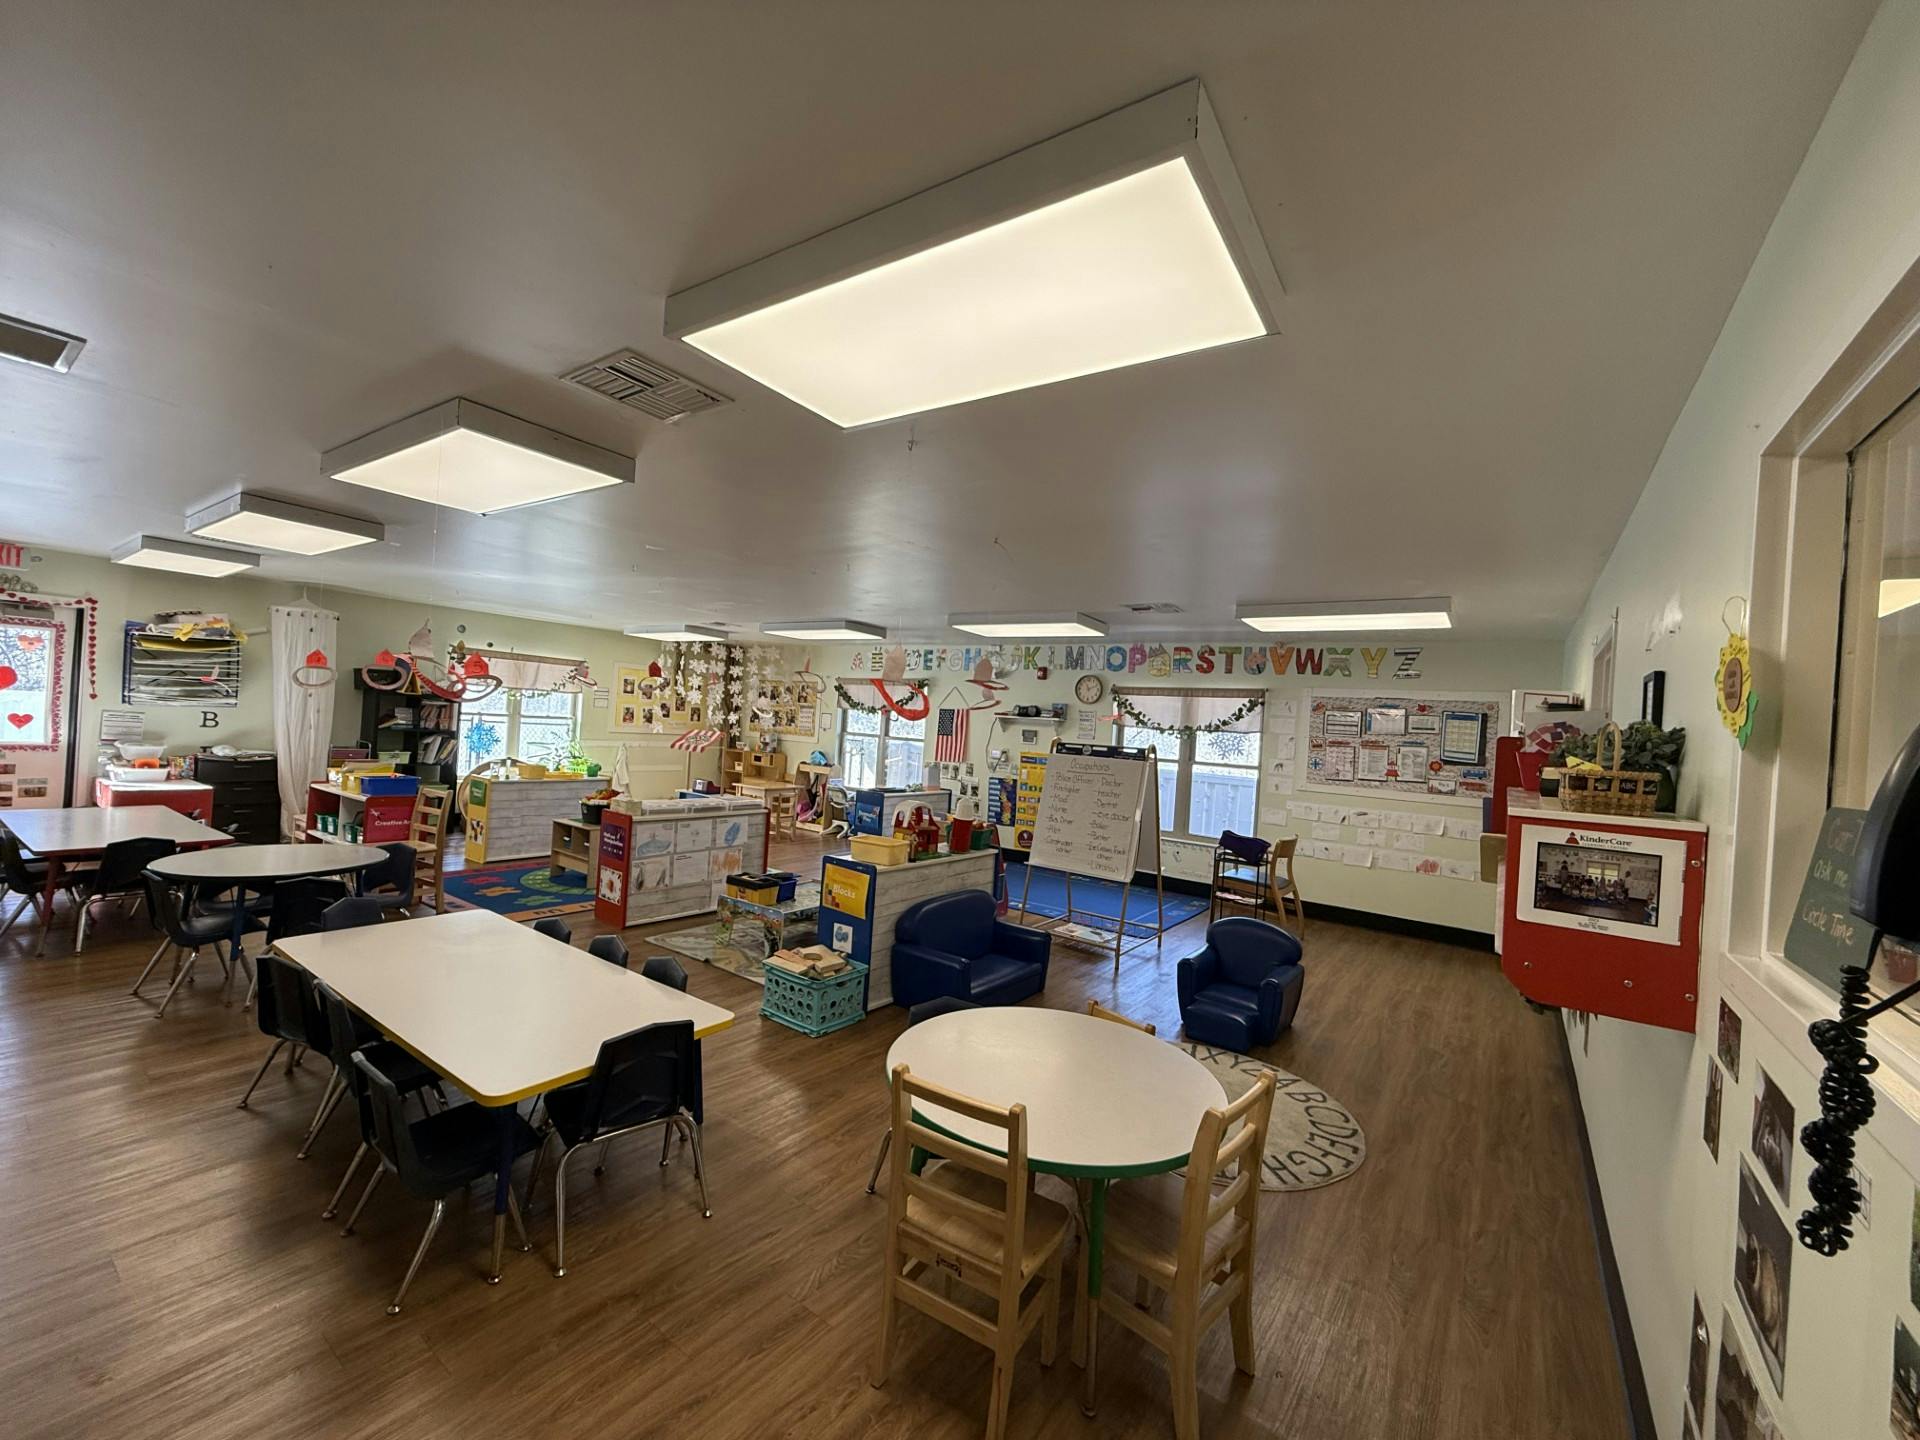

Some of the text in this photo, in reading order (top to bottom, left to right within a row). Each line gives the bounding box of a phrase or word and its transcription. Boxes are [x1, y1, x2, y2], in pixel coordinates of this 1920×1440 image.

[851, 651, 863, 671] A
[871, 646, 883, 671] B
[923, 649, 933, 670] E
[948, 649, 962, 671] G
[963, 648, 981, 671] H
[1024, 647, 1040, 669] K
[1065, 646, 1084, 670] M
[1085, 646, 1104, 670] N
[1106, 646, 1127, 672] O
[1128, 643, 1147, 673] P
[1173, 647, 1193, 673] R
[1196, 645, 1216, 674] S
[1218, 647, 1242, 674] T
[1244, 646, 1266, 675] U
[1269, 646, 1295, 675] V
[1296, 648, 1324, 675] W
[1323, 647, 1354, 677] X
[1360, 647, 1387, 678] Y
[1392, 647, 1424, 680] Z
[199, 711, 220, 728] B
[1620, 782, 1636, 790] ABC
[1580, 834, 1632, 847] KinderCare
[833, 883, 856, 899] Blocks
[1830, 912, 1855, 945] Time
